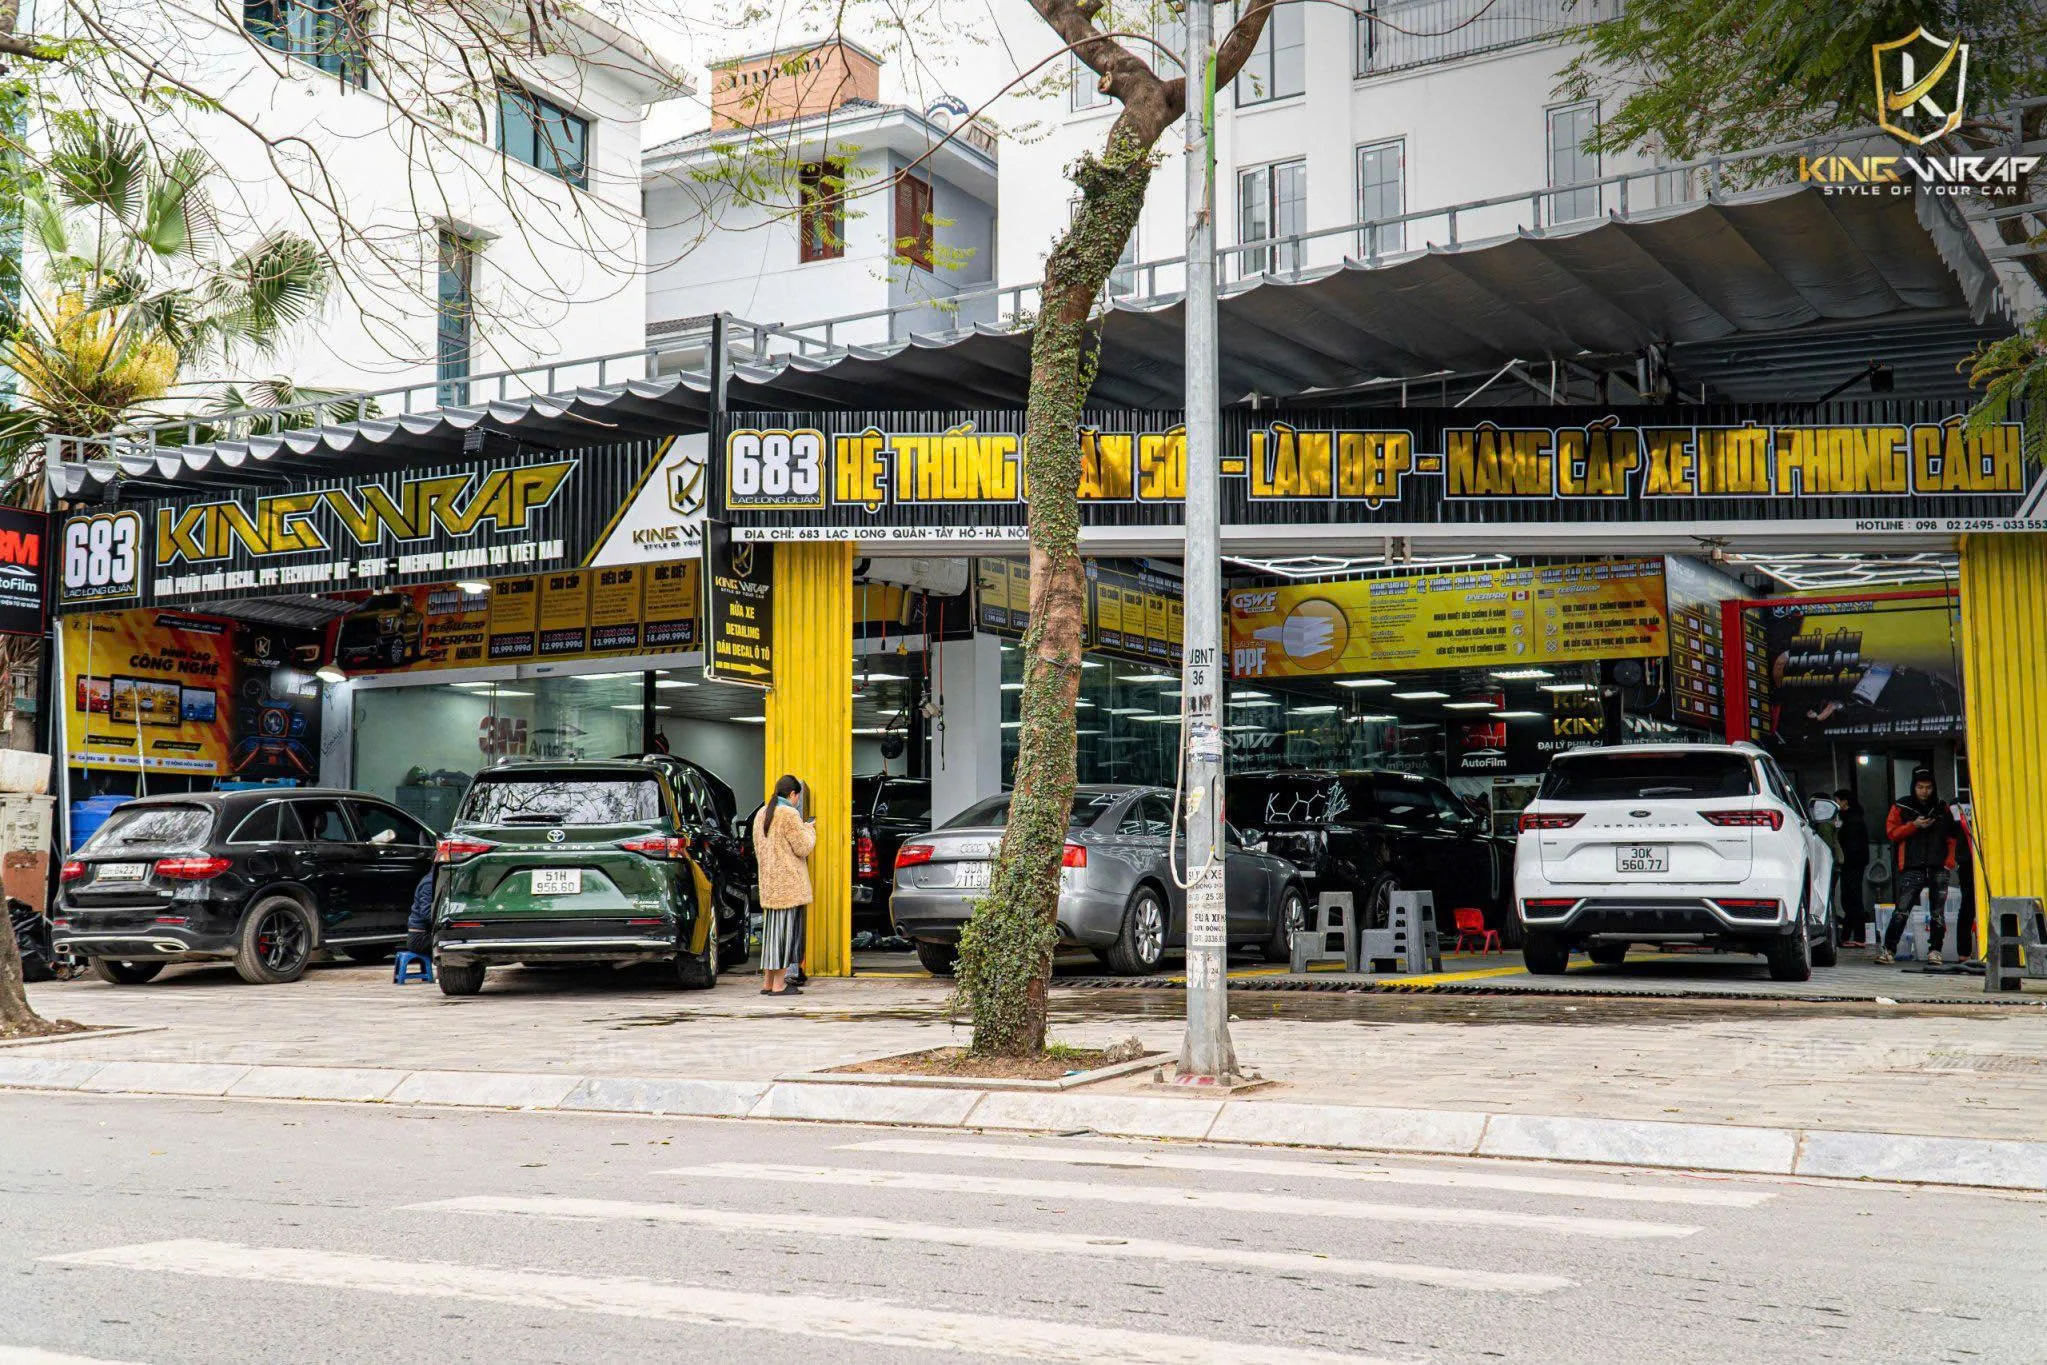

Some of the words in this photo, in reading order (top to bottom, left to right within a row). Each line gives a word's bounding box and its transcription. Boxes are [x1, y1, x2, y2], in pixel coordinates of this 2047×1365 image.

[732, 434, 820, 495] 683
[835, 429, 884, 511] HỆ
[891, 422, 1017, 500] THỐNG
[1138, 426, 1186, 498] SÓ
[1251, 425, 1331, 496] LÀM
[1448, 423, 1551, 495] NÂNG
[1558, 416, 1638, 495] CẤP
[1646, 430, 1693, 494] XE
[1776, 428, 1907, 493] PHONG
[1913, 416, 2022, 491] CÁCH
[752, 496, 786, 504] LONG
[156, 491, 331, 567] KING
[321, 459, 579, 547] WRAP
[1855, 521, 1904, 531] HOTLINE
[1915, 520, 1937, 531] 098
[633, 525, 679, 544] KING
[744, 529, 765, 541] ĐỊA
[770, 527, 794, 539] CHỈ:
[799, 529, 820, 539] 683
[855, 529, 886, 539] LONG
[892, 527, 927, 539] QUÂN
[935, 527, 954, 539] TÂY
[959, 526, 976, 539] HỒ
[986, 527, 1002, 539] HÀ
[65, 516, 137, 589] 683
[715, 576, 738, 589] KING
[1231, 591, 1278, 609] GSWF
[745, 606, 755, 620] XE
[725, 622, 760, 640] DETAILING
[732, 642, 753, 658] DECAL
[129, 653, 173, 671] CÔNG
[177, 658, 220, 680] NGHỆ
[1234, 647, 1267, 676] PPF
[1192, 670, 1204, 685] 36
[1553, 717, 1603, 736] KIN
[1461, 757, 1507, 768] AutoFilm
[1631, 848, 1652, 859] 30K
[1621, 859, 1662, 871] 560.77
[546, 871, 567, 882] 51H
[537, 882, 575, 892] 956.60
